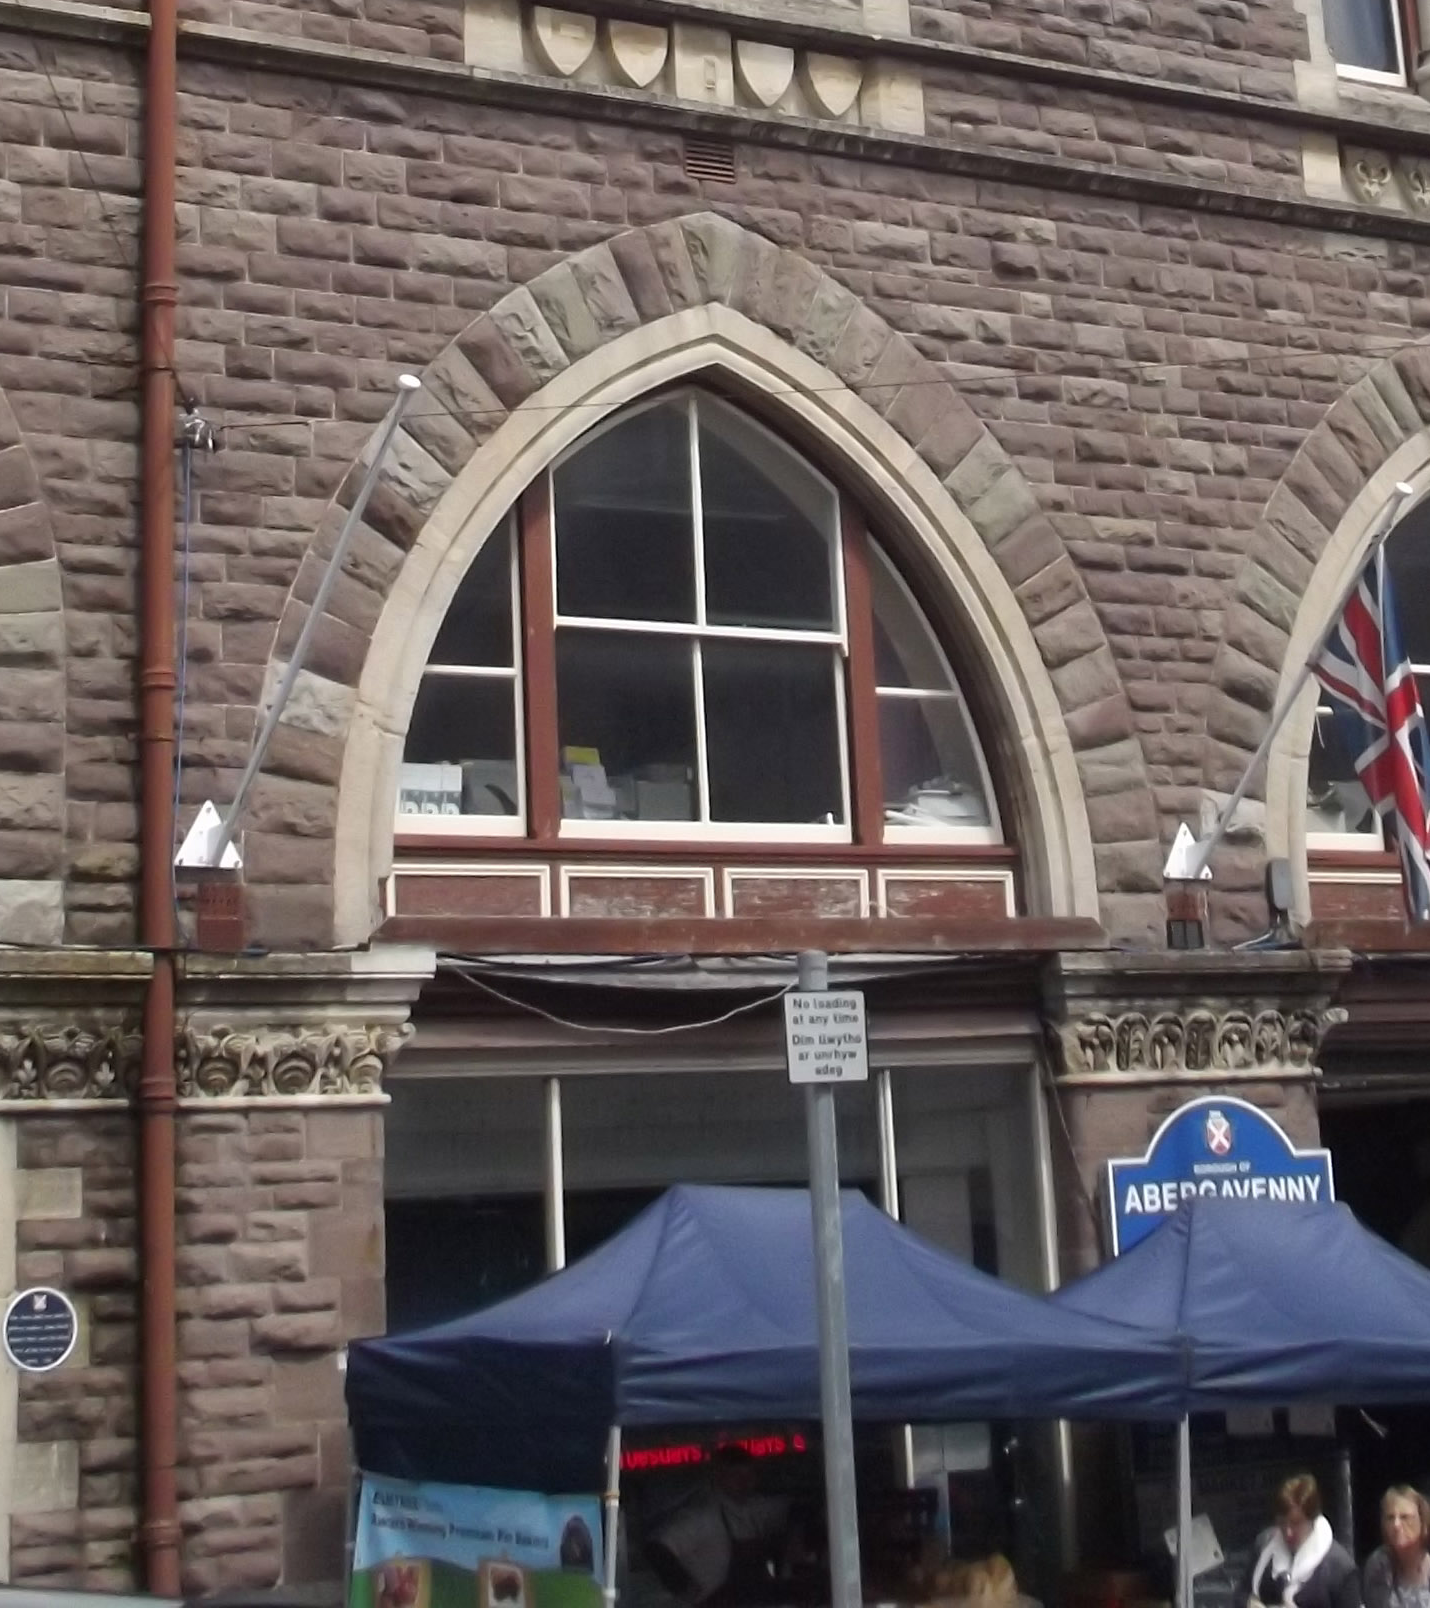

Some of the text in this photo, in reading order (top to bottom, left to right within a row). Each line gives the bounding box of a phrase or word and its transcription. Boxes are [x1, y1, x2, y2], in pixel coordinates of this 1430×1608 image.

[792, 998, 857, 1010] No loading
[808, 1015, 829, 1027] any
[833, 1013, 859, 1024] time
